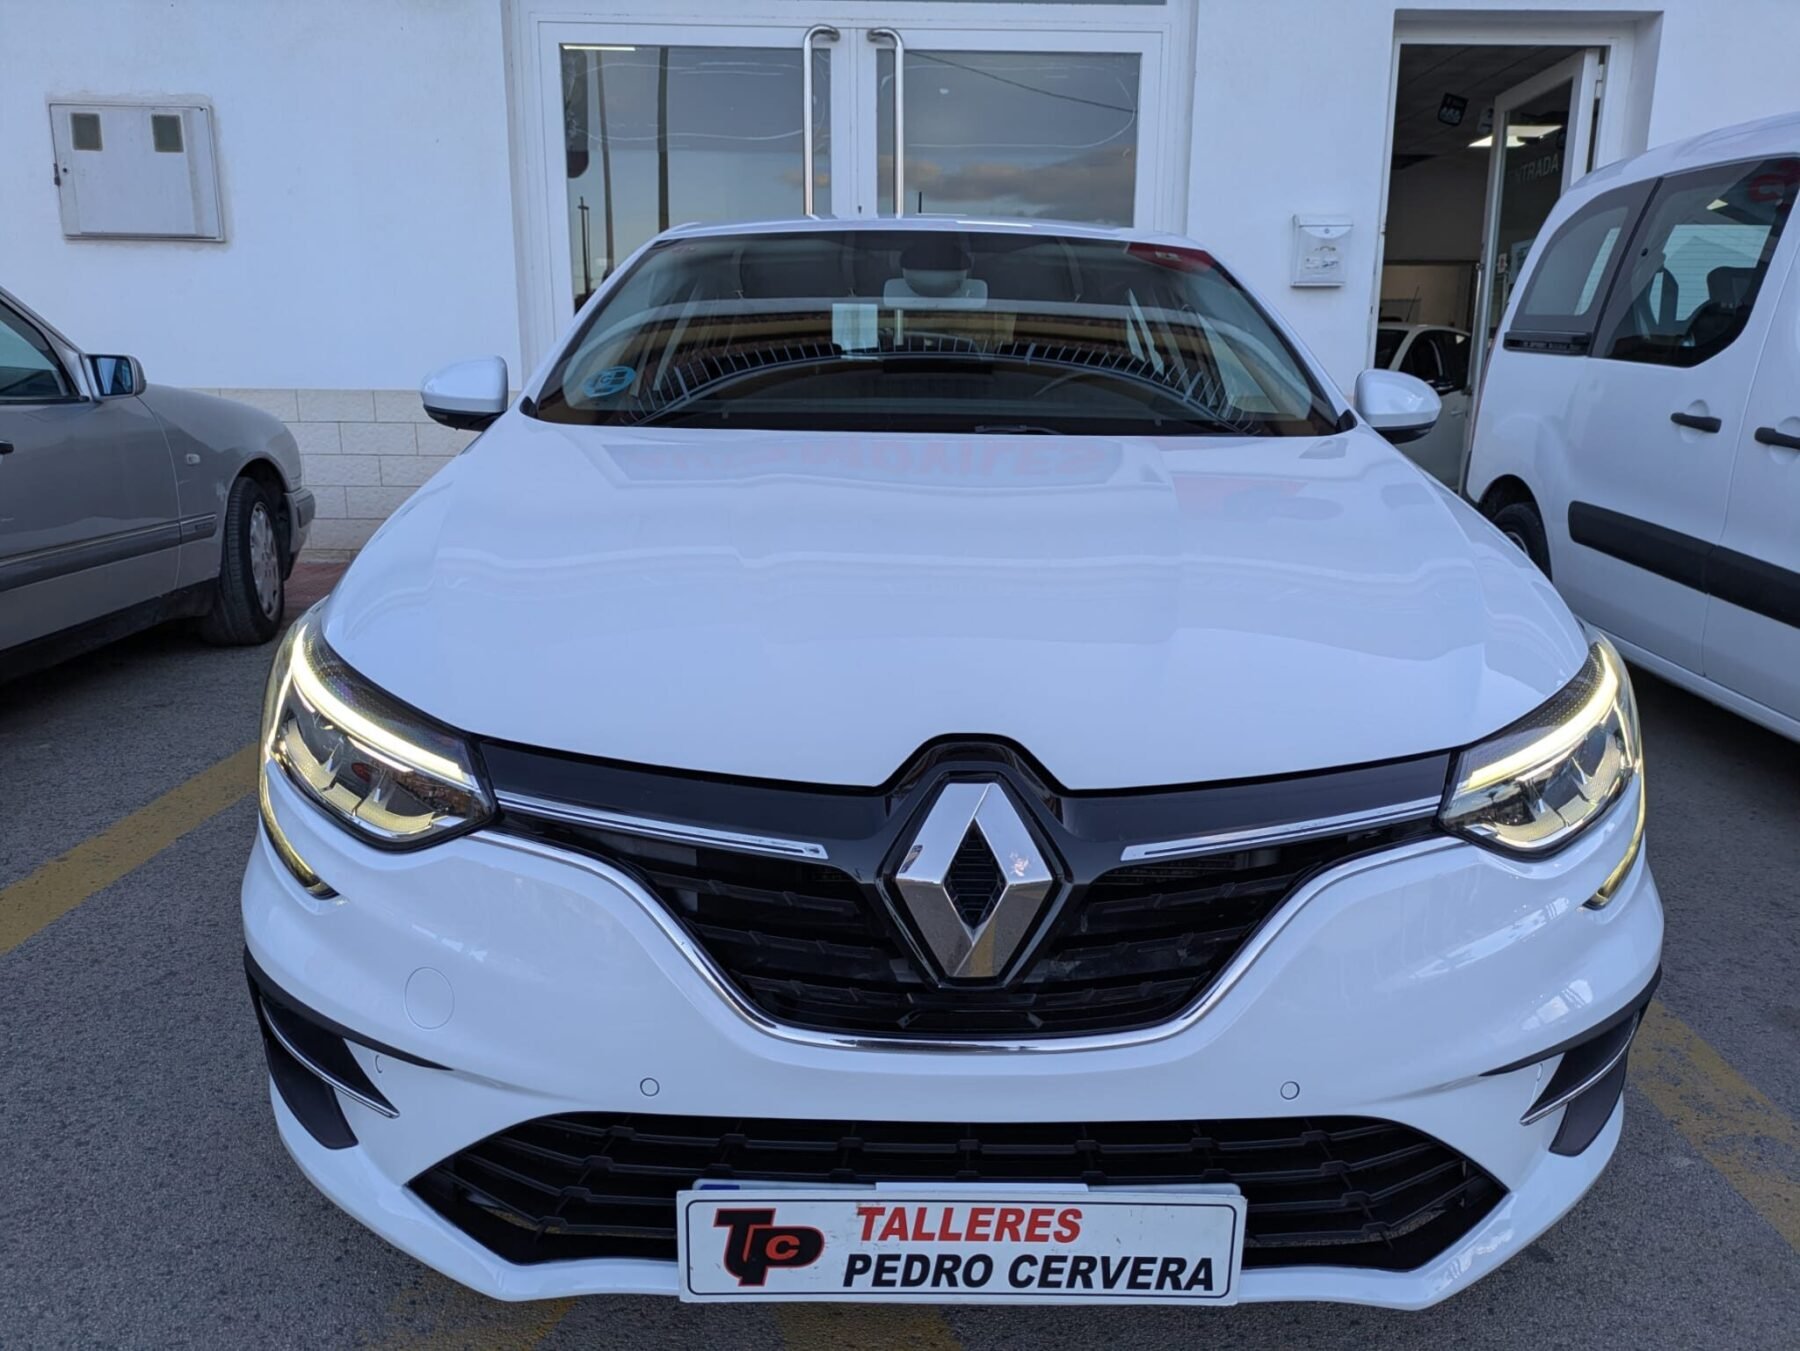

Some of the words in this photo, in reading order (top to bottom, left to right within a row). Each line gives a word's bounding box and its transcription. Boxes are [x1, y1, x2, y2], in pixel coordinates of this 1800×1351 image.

[857, 1207, 1083, 1243] TALLERES
[843, 1254, 993, 1288] PEDRO
[1008, 1254, 1214, 1291] CERVERA
